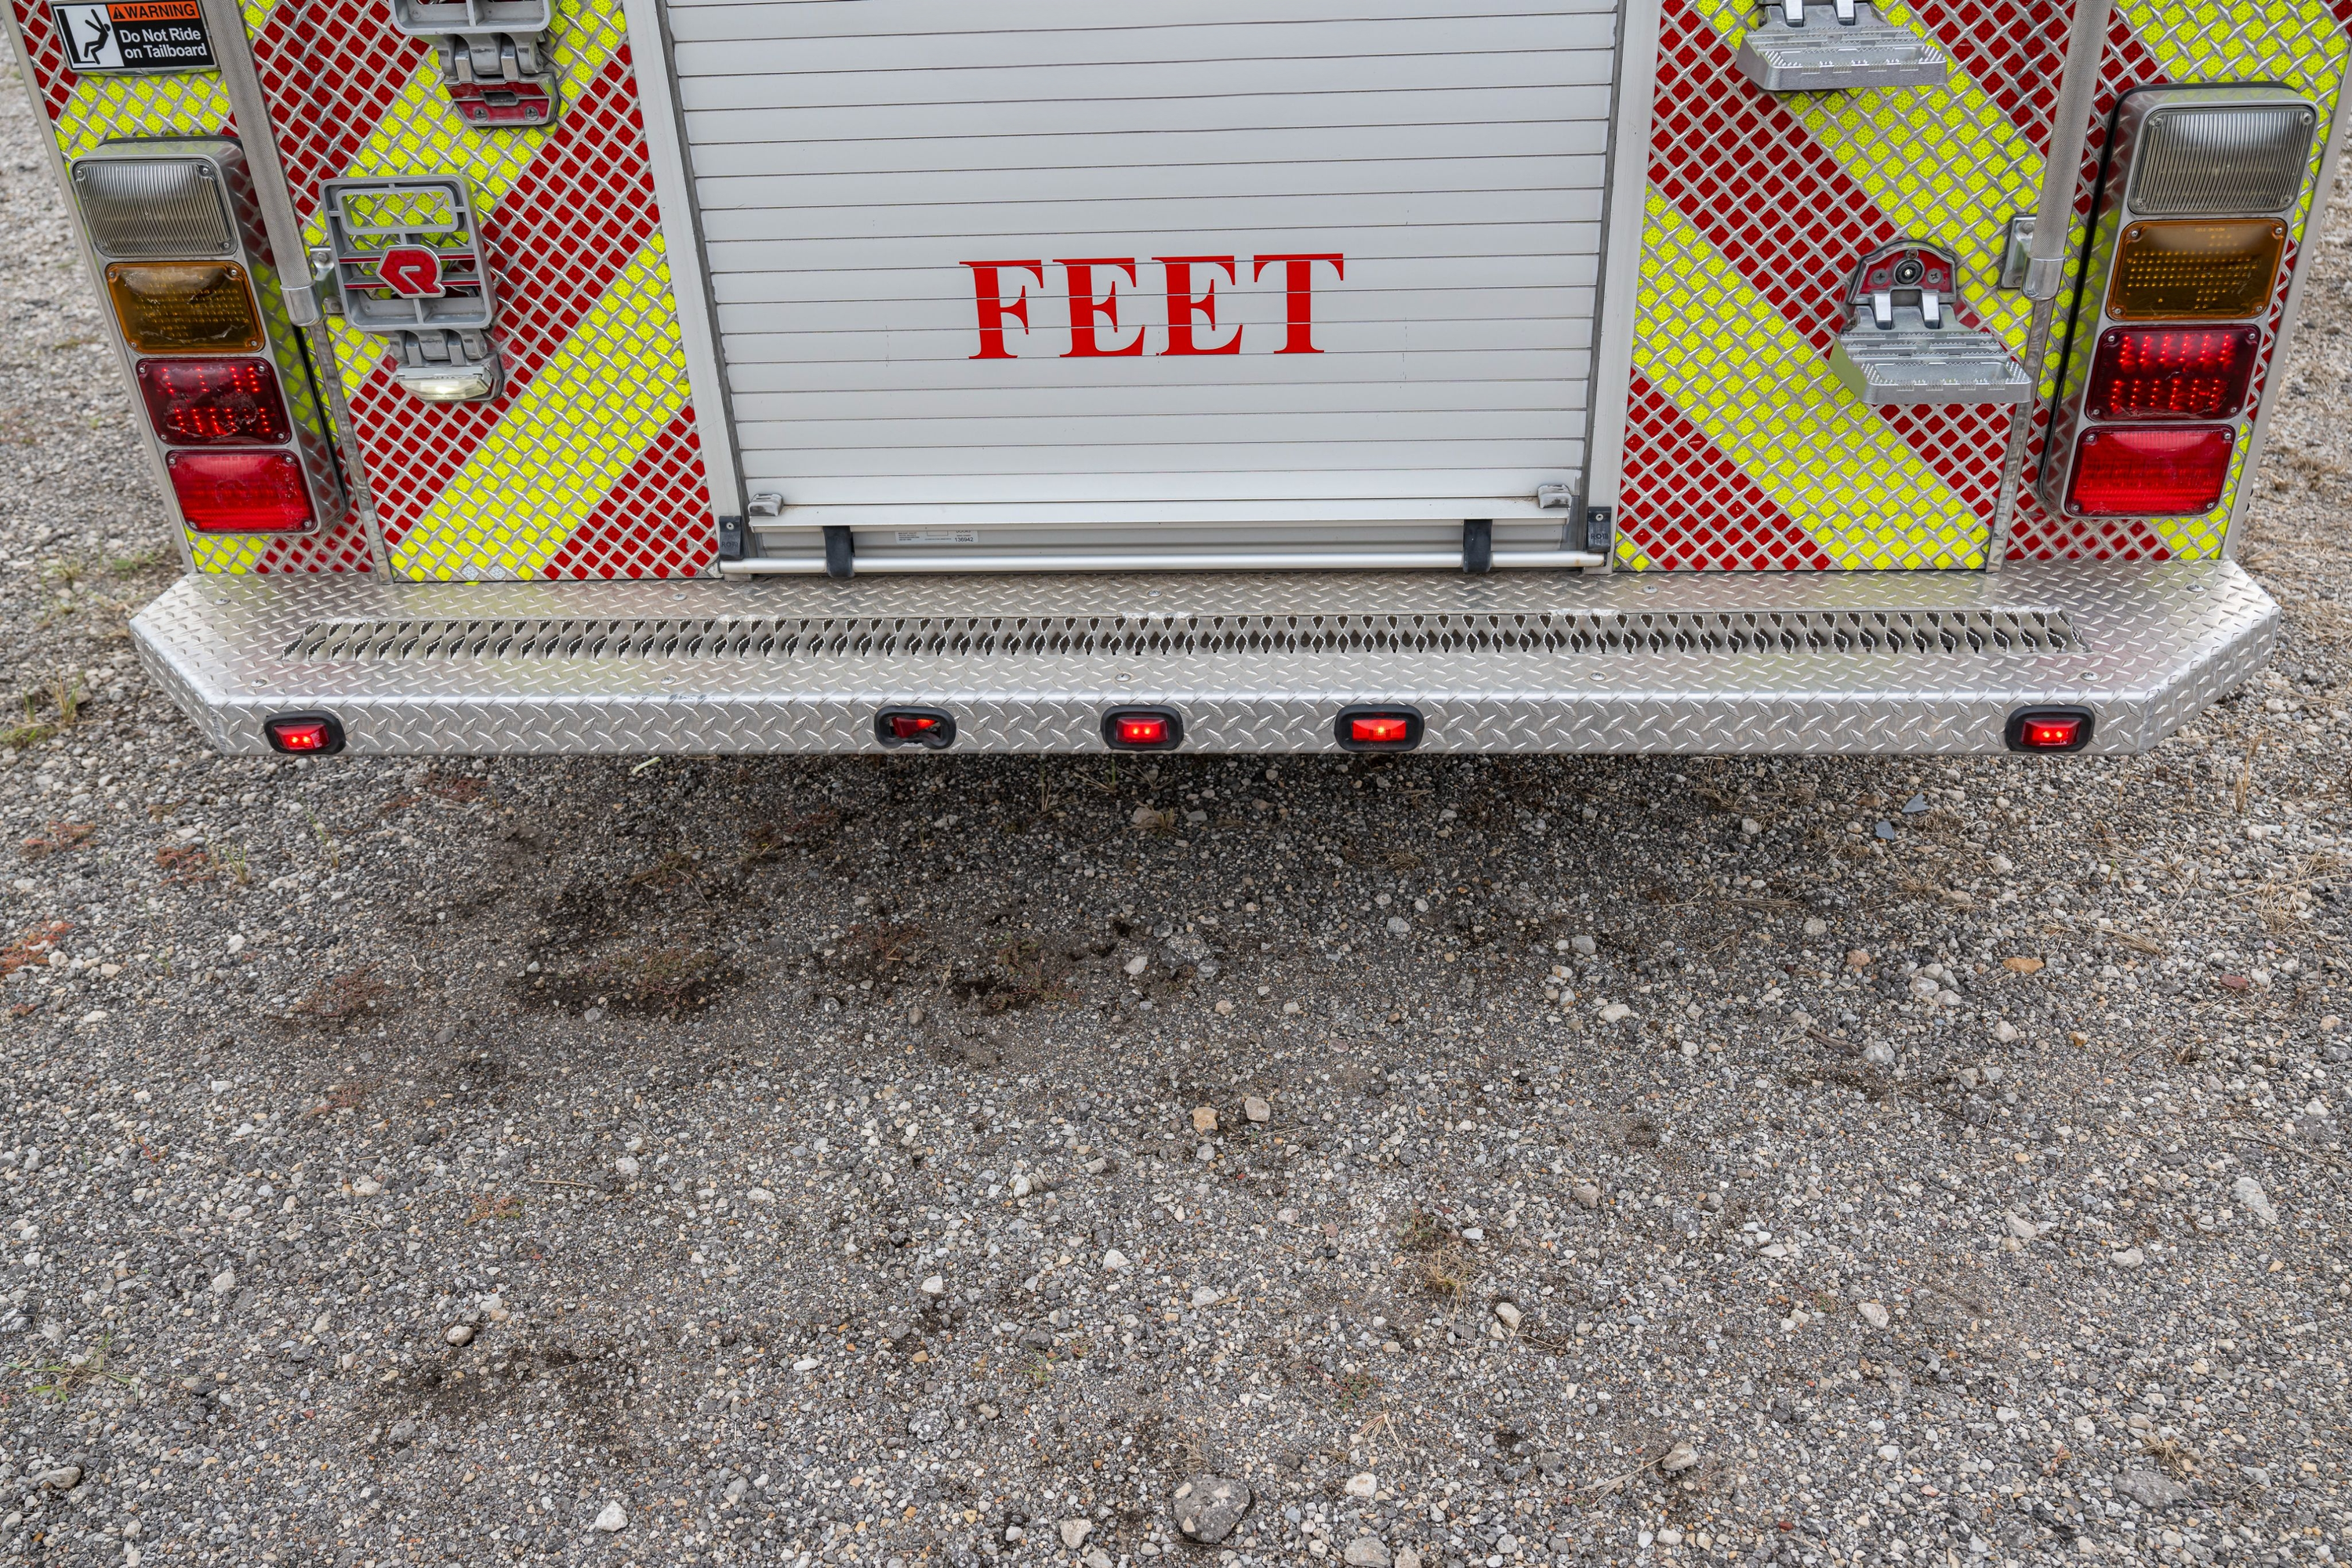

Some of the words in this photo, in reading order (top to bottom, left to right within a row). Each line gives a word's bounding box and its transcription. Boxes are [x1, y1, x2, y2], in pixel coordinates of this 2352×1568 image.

[124, 3, 196, 19] WARNING
[119, 29, 140, 43] Do
[142, 28, 169, 42] Not
[167, 27, 201, 41] Ride
[125, 48, 143, 59] on
[143, 42, 208, 58] Tailboard
[958, 252, 1344, 360] FEET
